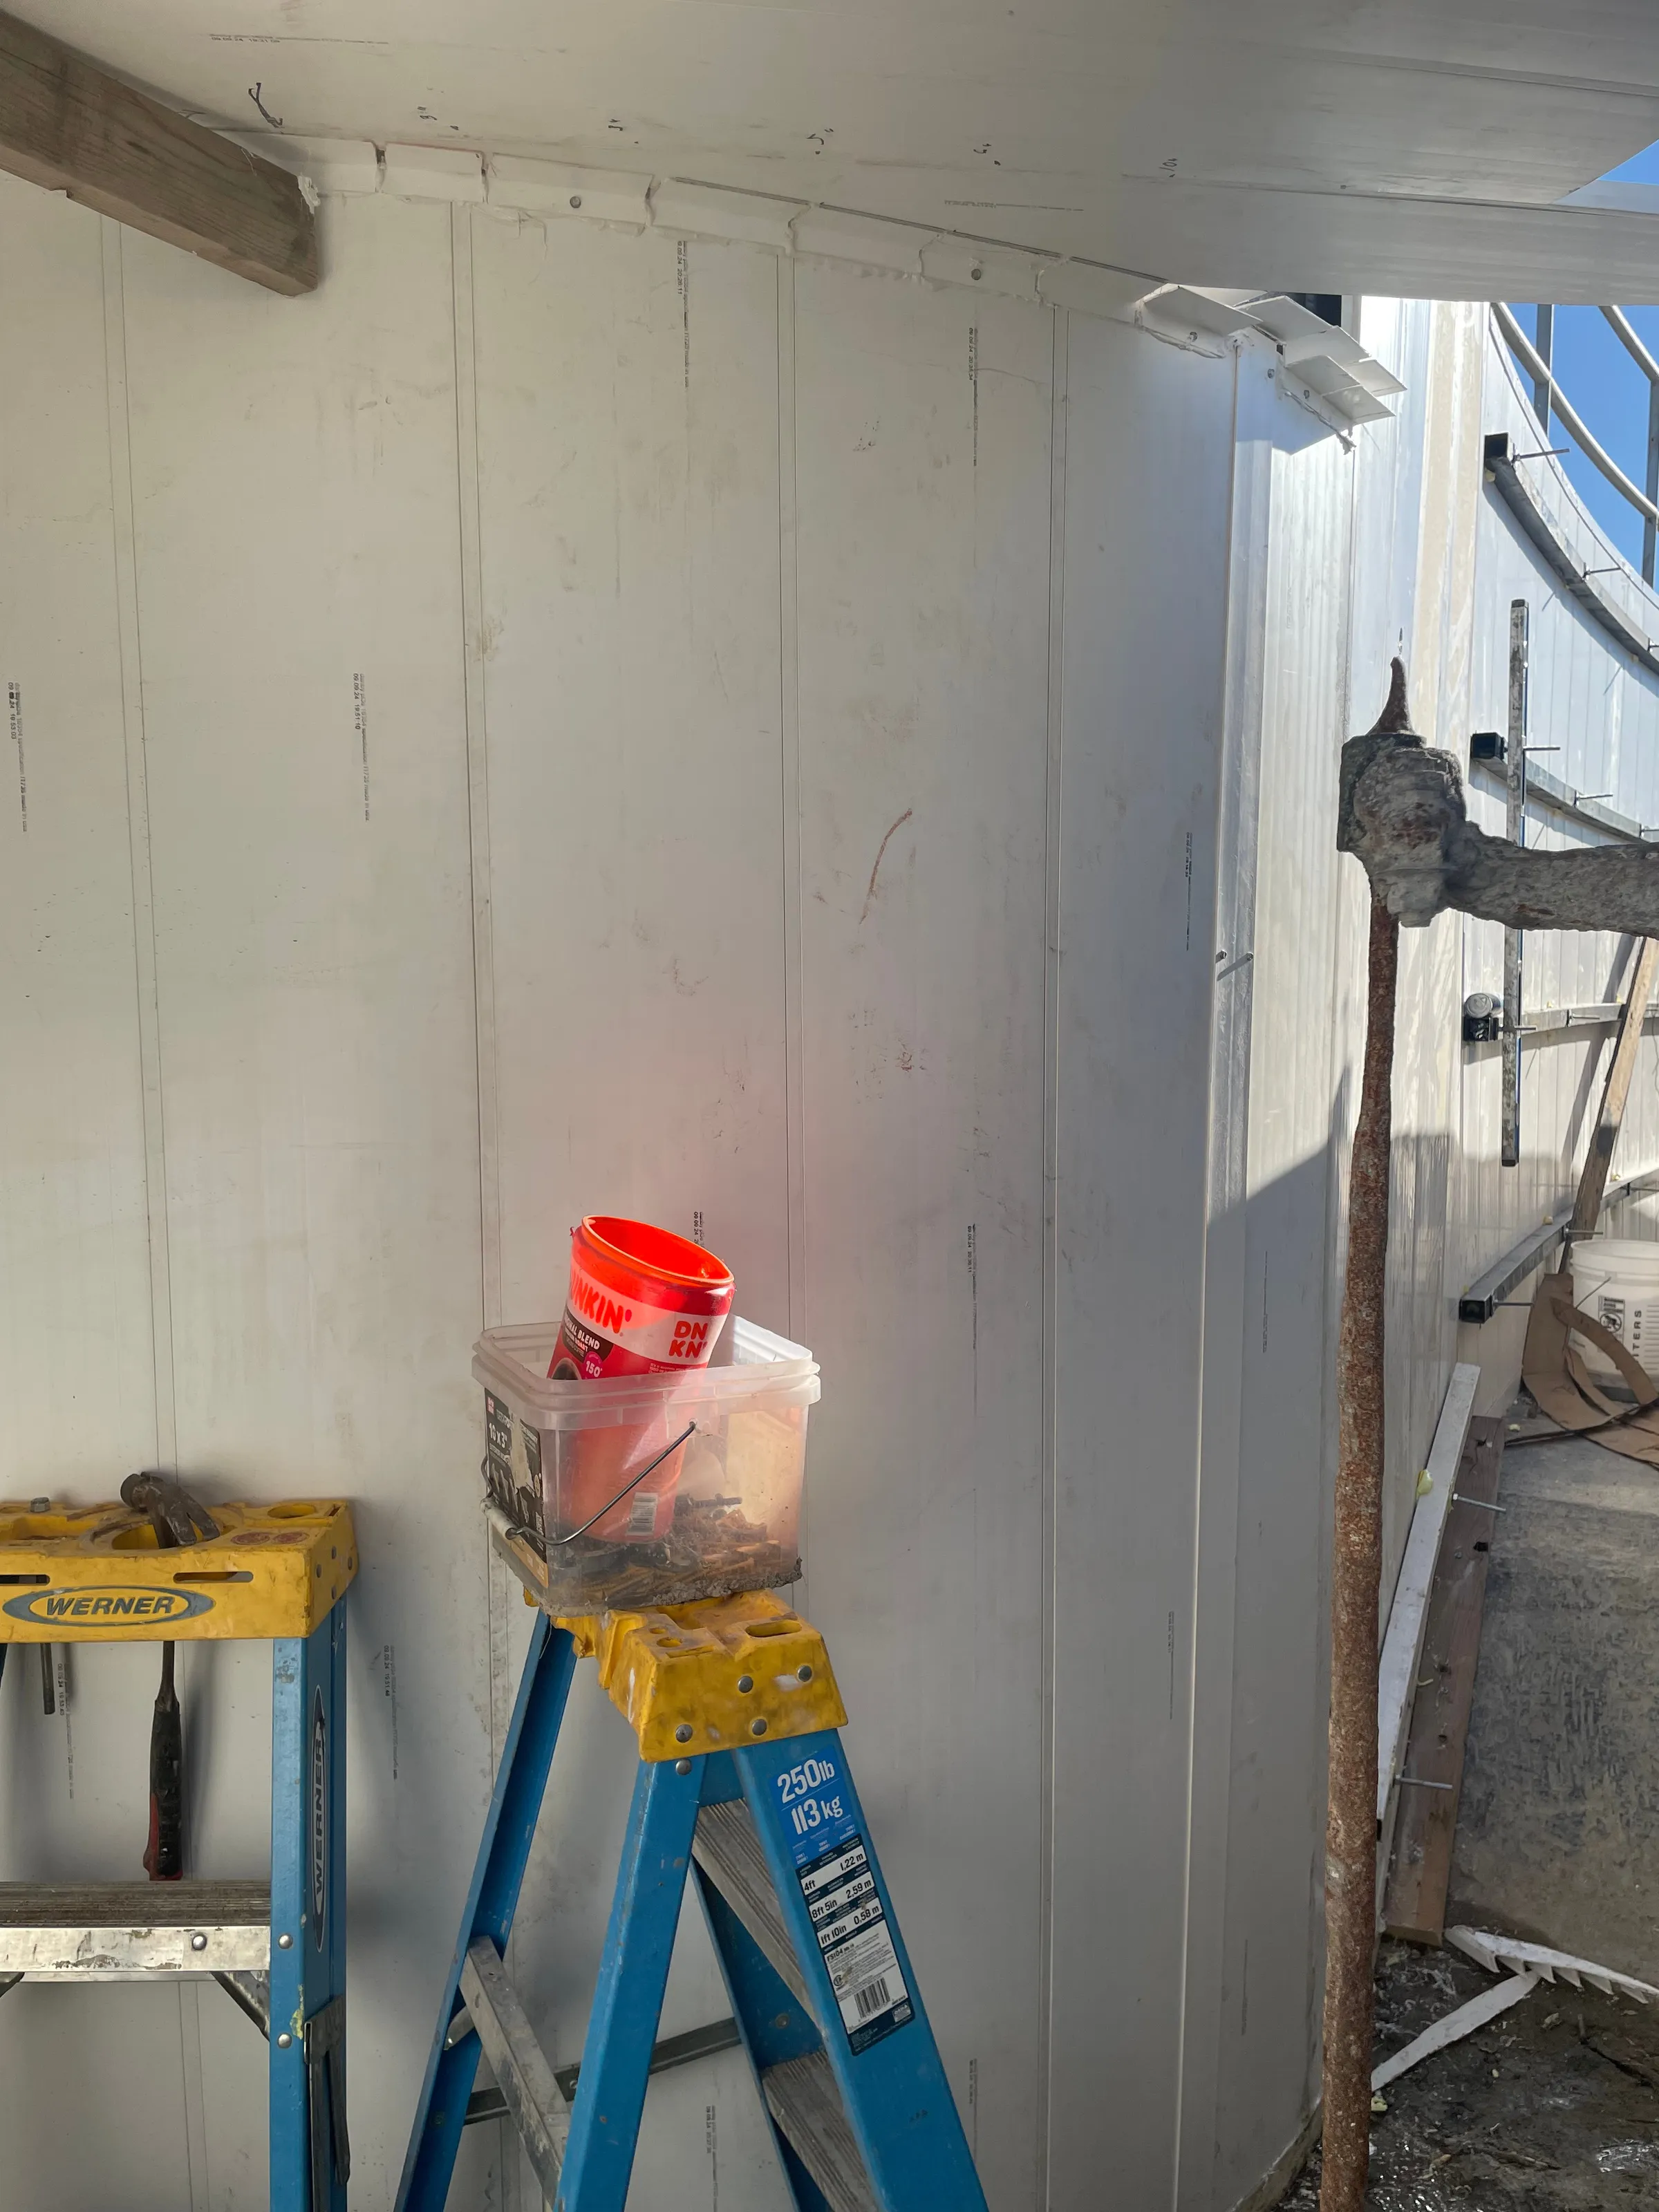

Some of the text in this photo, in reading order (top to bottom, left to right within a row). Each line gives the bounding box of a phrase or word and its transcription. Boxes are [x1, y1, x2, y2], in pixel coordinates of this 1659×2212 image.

[577, 1329, 600, 1350] BLEND
[674, 1321, 708, 1340] DN
[1632, 1310, 1642, 1357] ITERS
[46, 1596, 176, 1615] WERNER
[791, 1799, 821, 1835] 113
[821, 1796, 843, 1820] kg
[804, 1880, 816, 1891] 4ft
[840, 1855, 856, 1871] 1,22
[856, 1853, 863, 1862] m
[812, 1880, 872, 1919] 8ft 5in 2,59 m
[821, 1933, 831, 1944] 1ft
[831, 1925, 847, 1938] 10in
[872, 1905, 879, 1915] m
